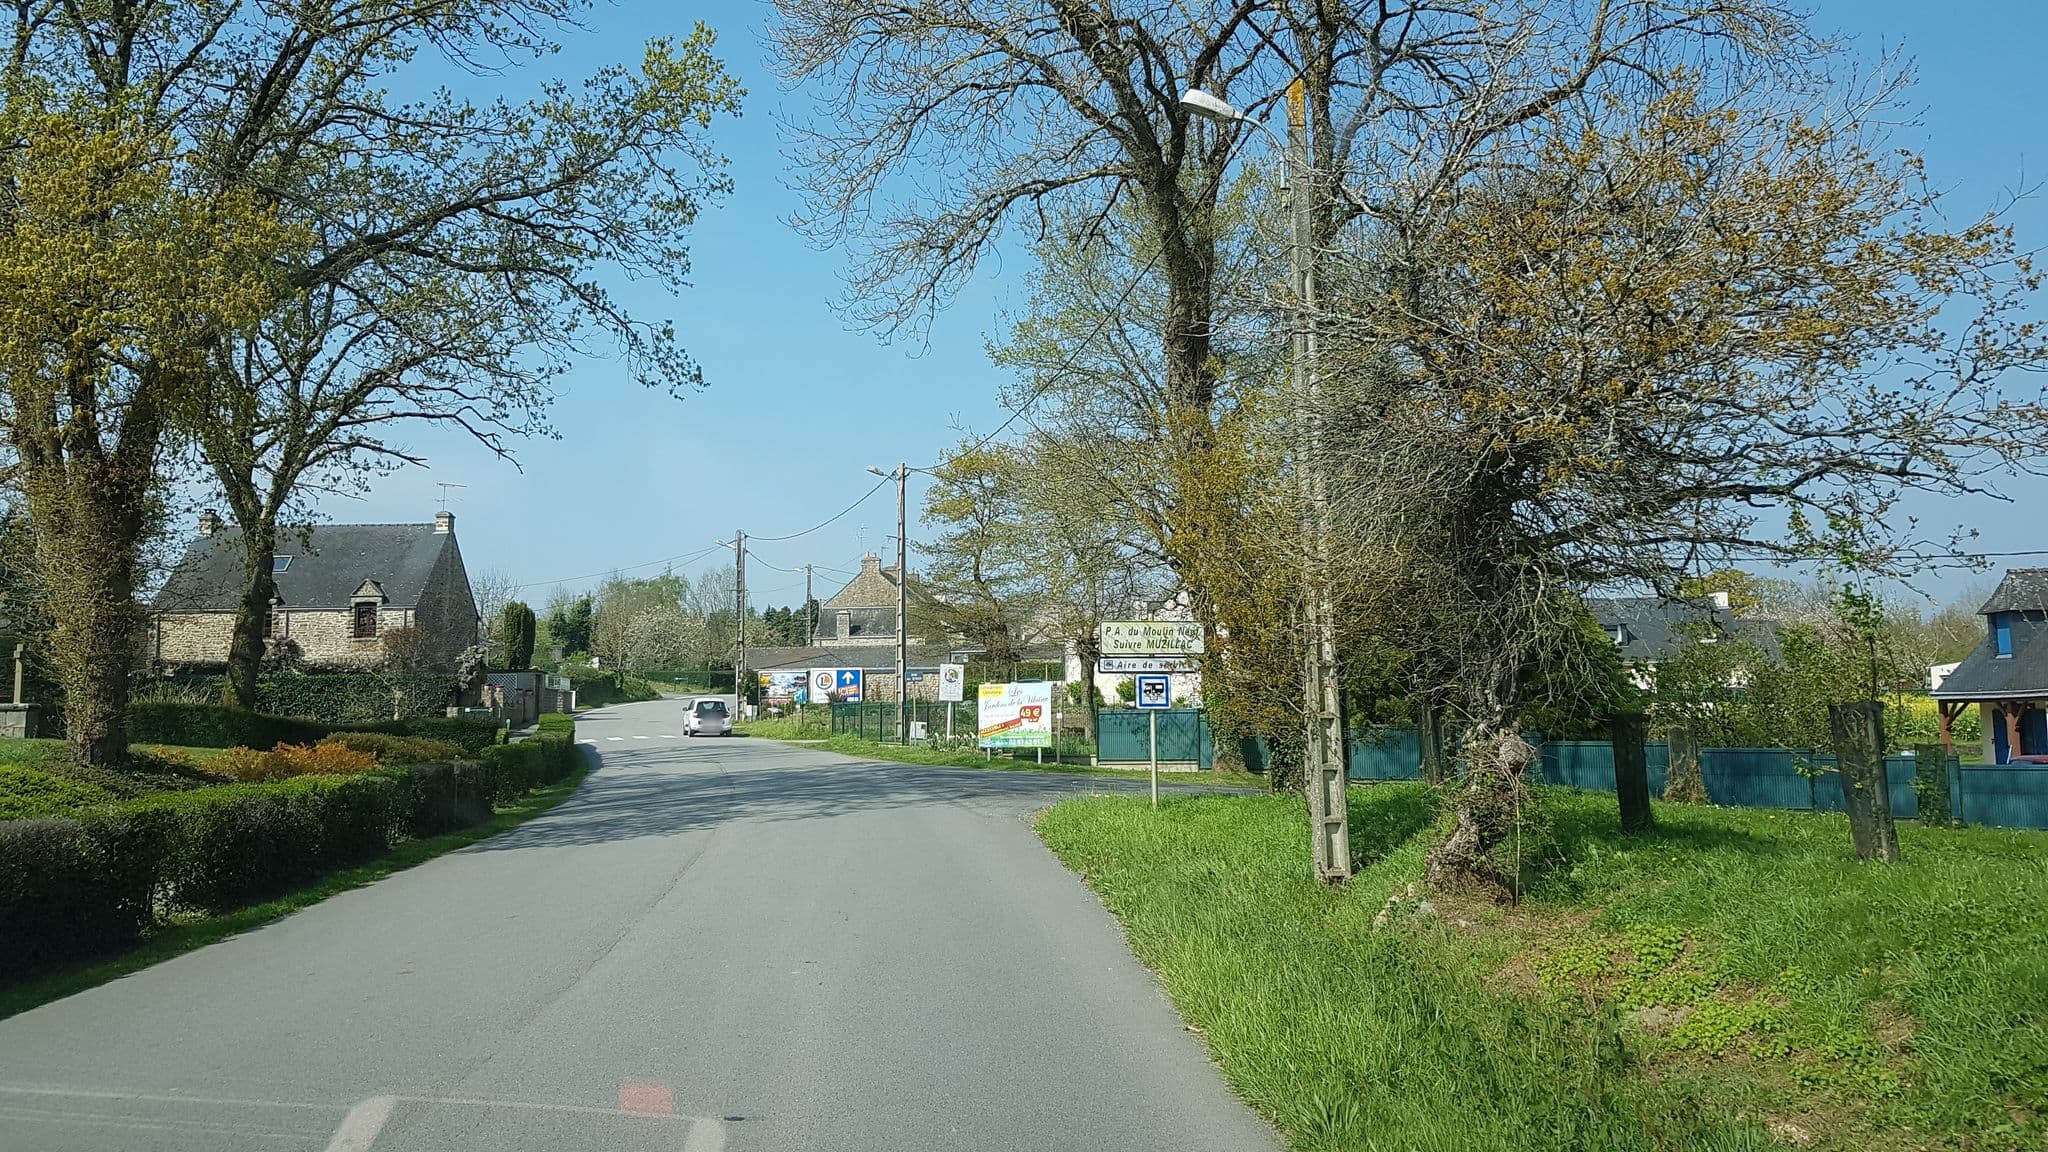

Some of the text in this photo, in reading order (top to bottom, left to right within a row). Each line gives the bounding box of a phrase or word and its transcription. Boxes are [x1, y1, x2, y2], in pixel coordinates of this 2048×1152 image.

[1105, 626, 1123, 636] P.A.
[1128, 626, 1139, 636] du
[1143, 626, 1174, 636] Moulin
[1113, 639, 1193, 649] Suivre MUZILLAC
[1116, 661, 1137, 669] Aire
[1142, 661, 1153, 669] de
